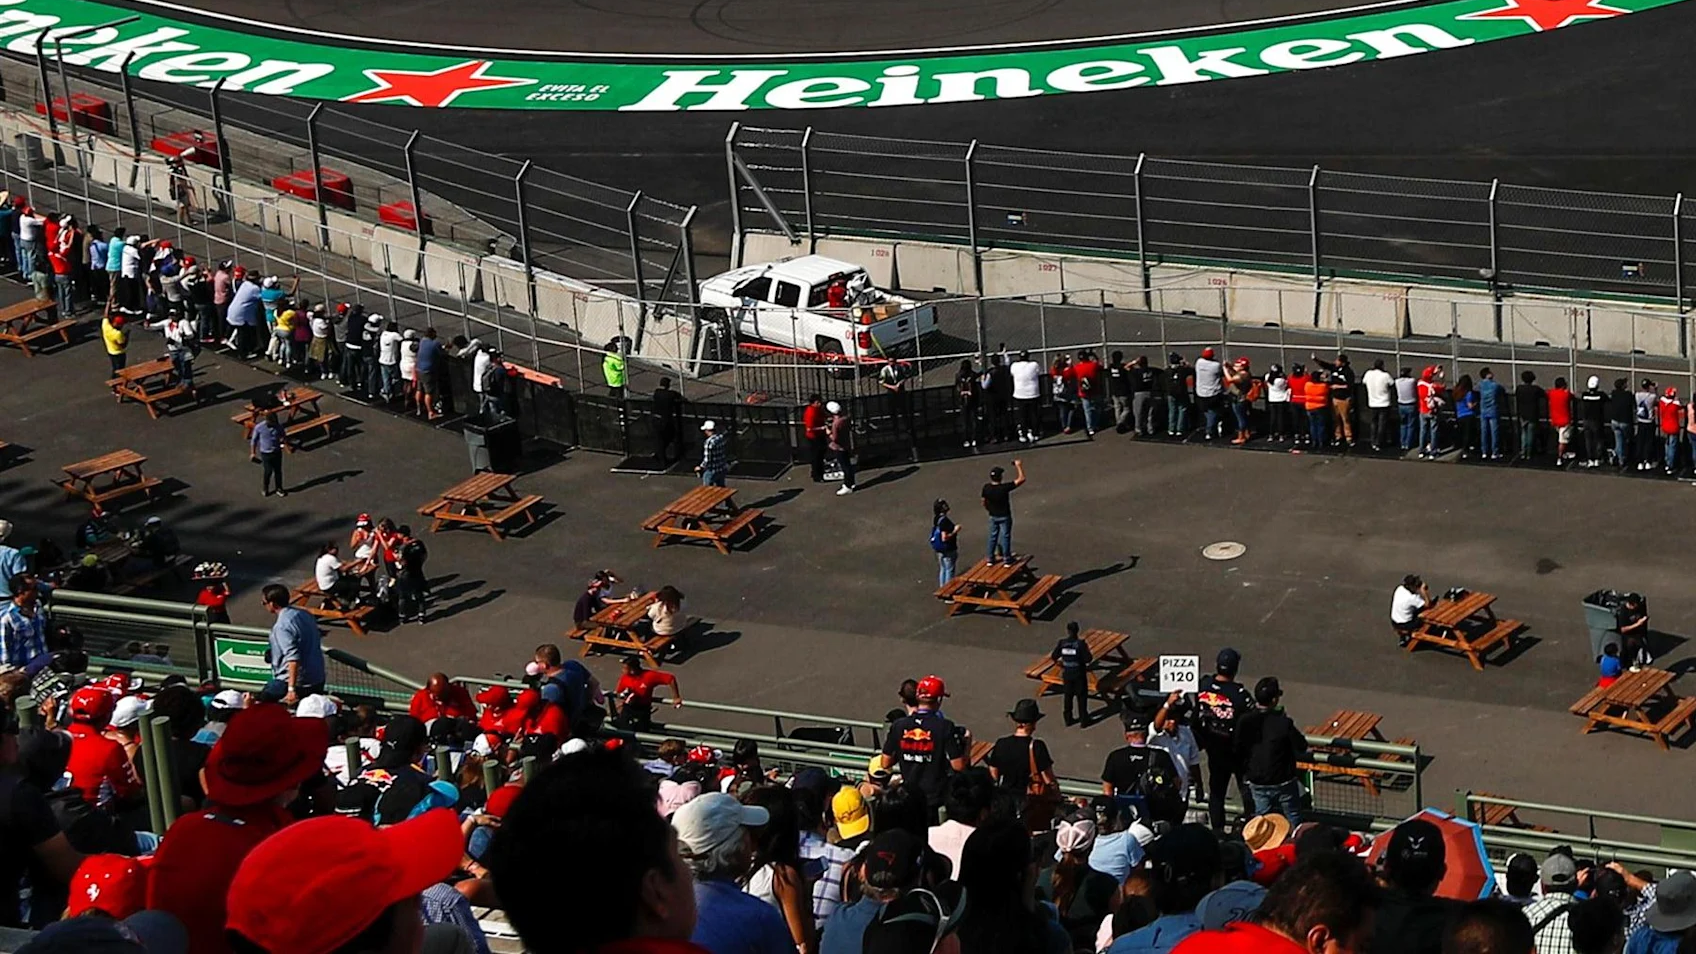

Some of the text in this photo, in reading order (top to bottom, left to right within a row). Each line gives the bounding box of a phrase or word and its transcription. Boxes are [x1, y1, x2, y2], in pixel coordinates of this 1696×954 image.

[617, 22, 1476, 111] Heineken
[539, 84, 611, 94] EVITA EL
[525, 93, 600, 102] EXCESO
[1162, 658, 1195, 668] PIZZA
[1164, 671, 1194, 683] $120
